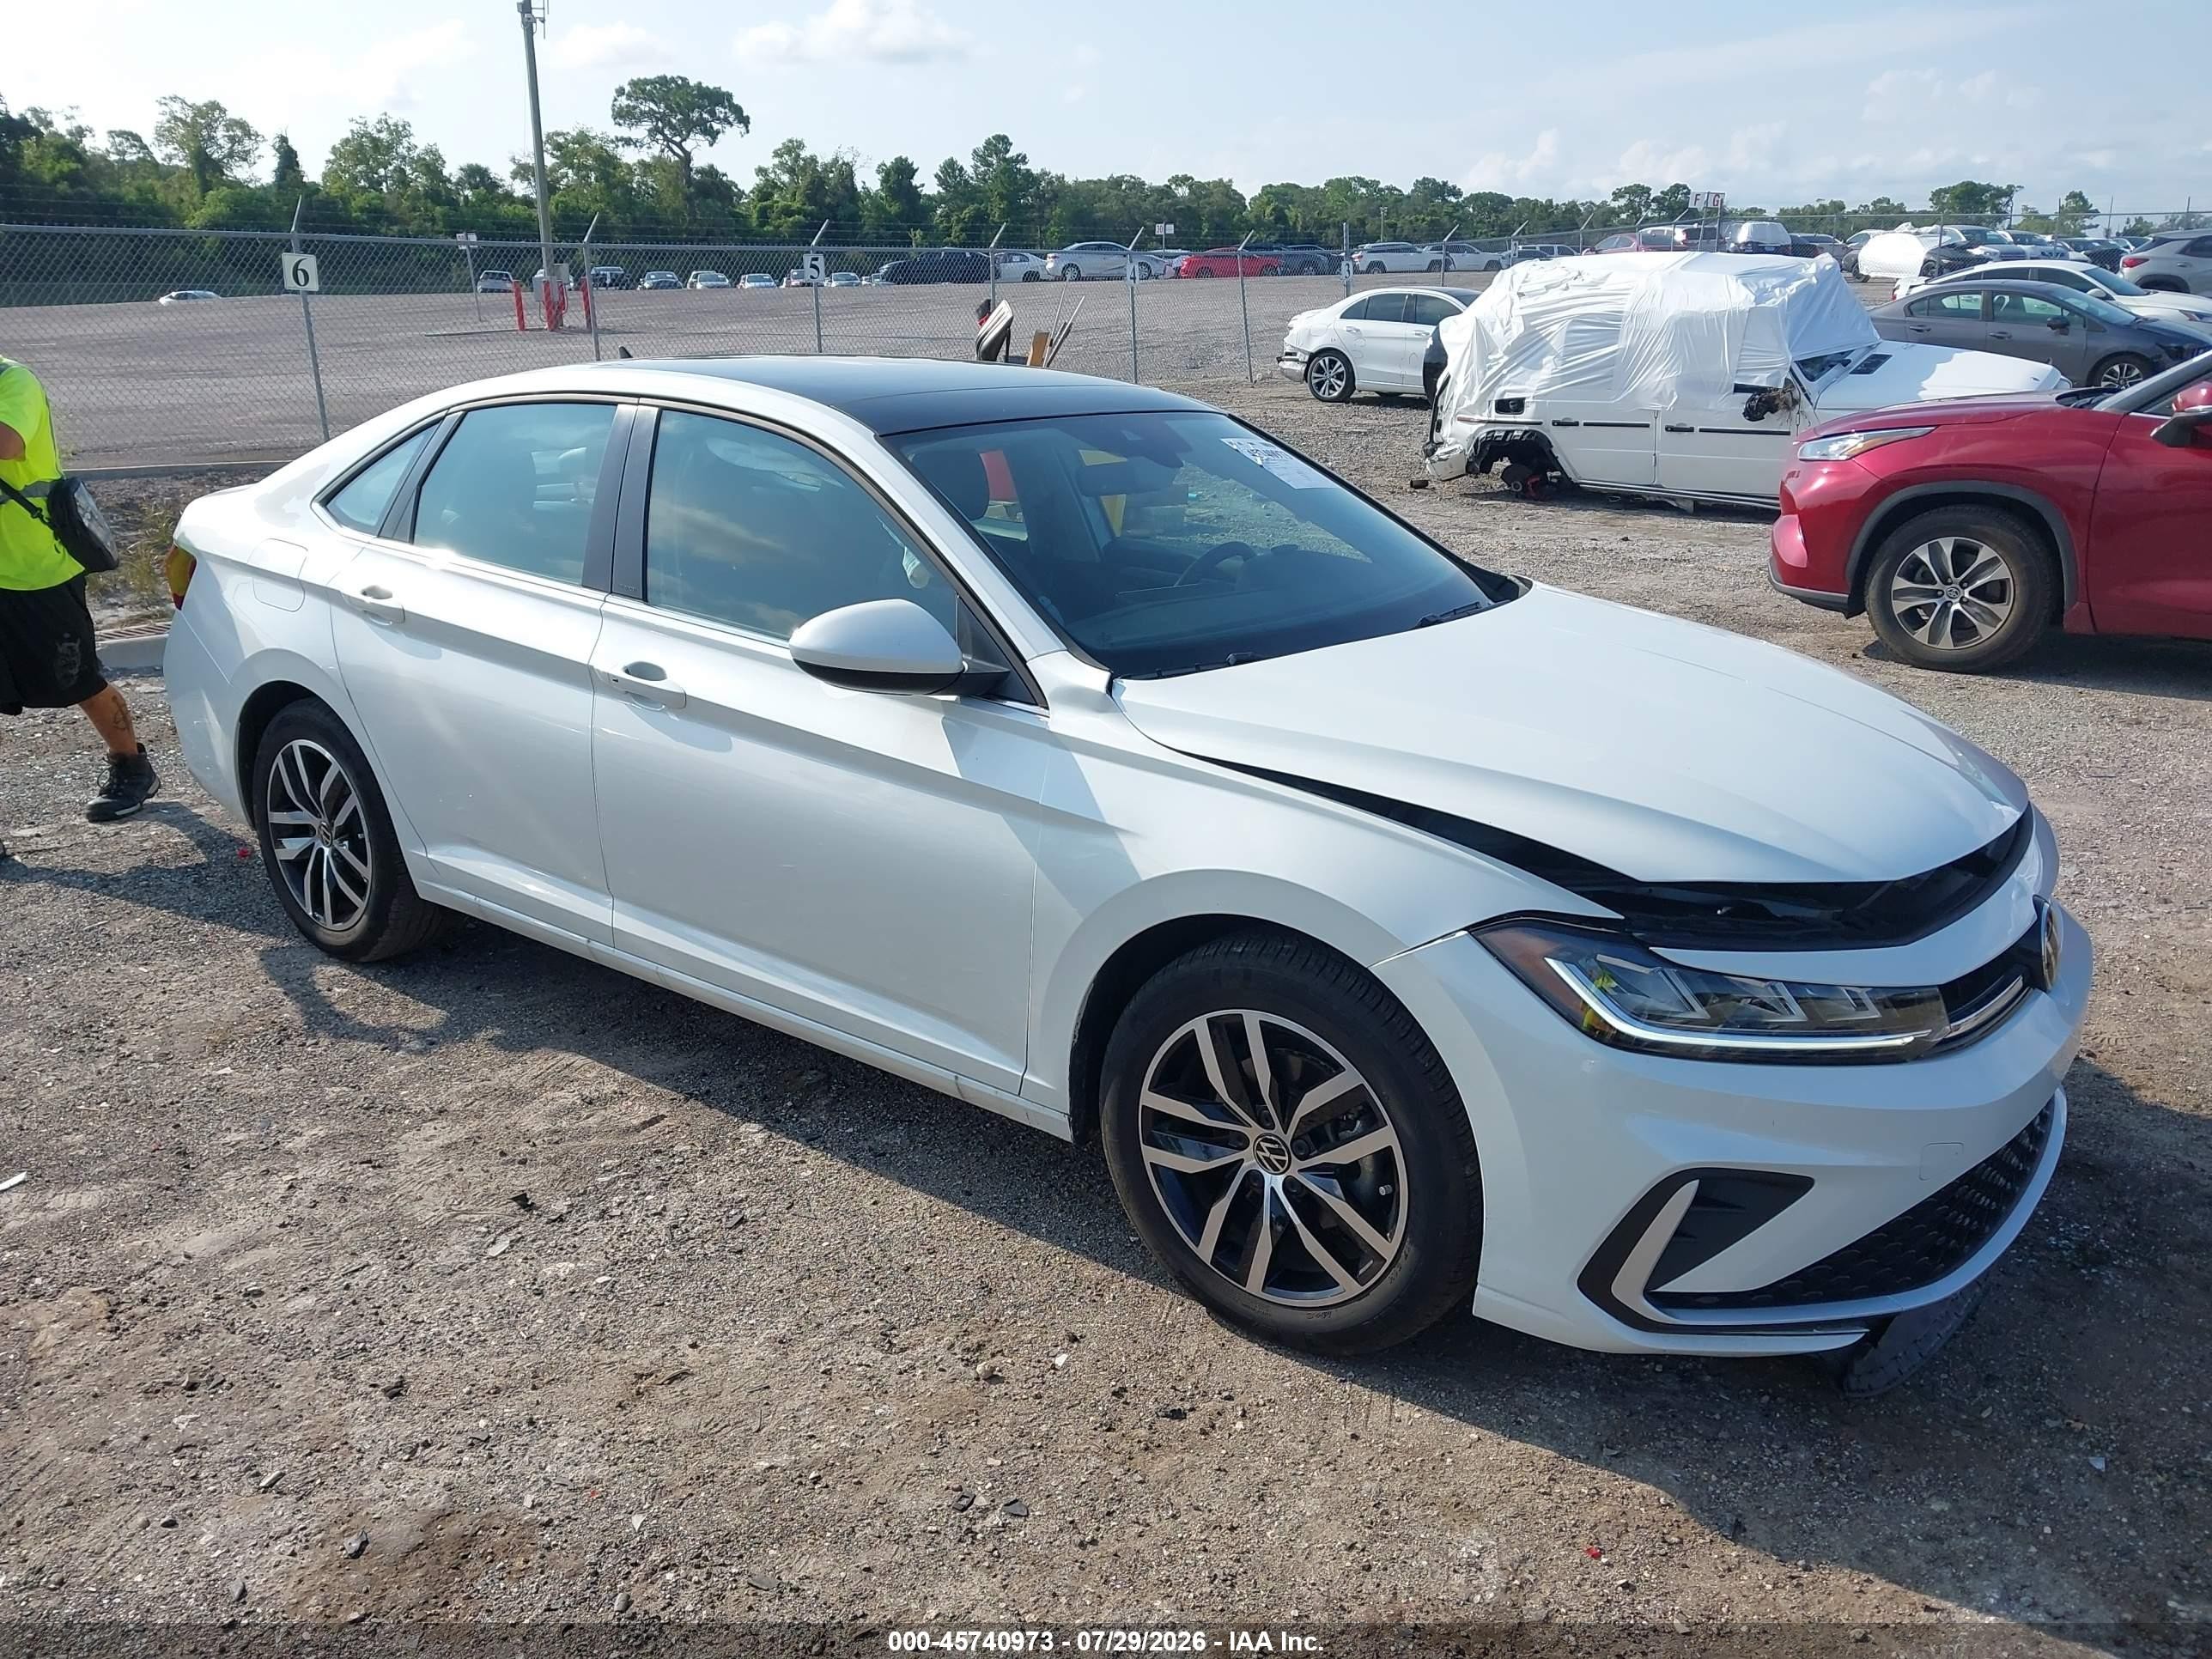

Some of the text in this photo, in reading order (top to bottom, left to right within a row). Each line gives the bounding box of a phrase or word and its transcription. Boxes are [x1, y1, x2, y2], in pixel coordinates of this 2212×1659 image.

[1694, 193, 1701, 207] F
[1712, 193, 1721, 207] G
[292, 258, 309, 287] 6
[809, 257, 820, 280] 5
[1129, 265, 1136, 284] 4
[1345, 262, 1351, 279] 3
